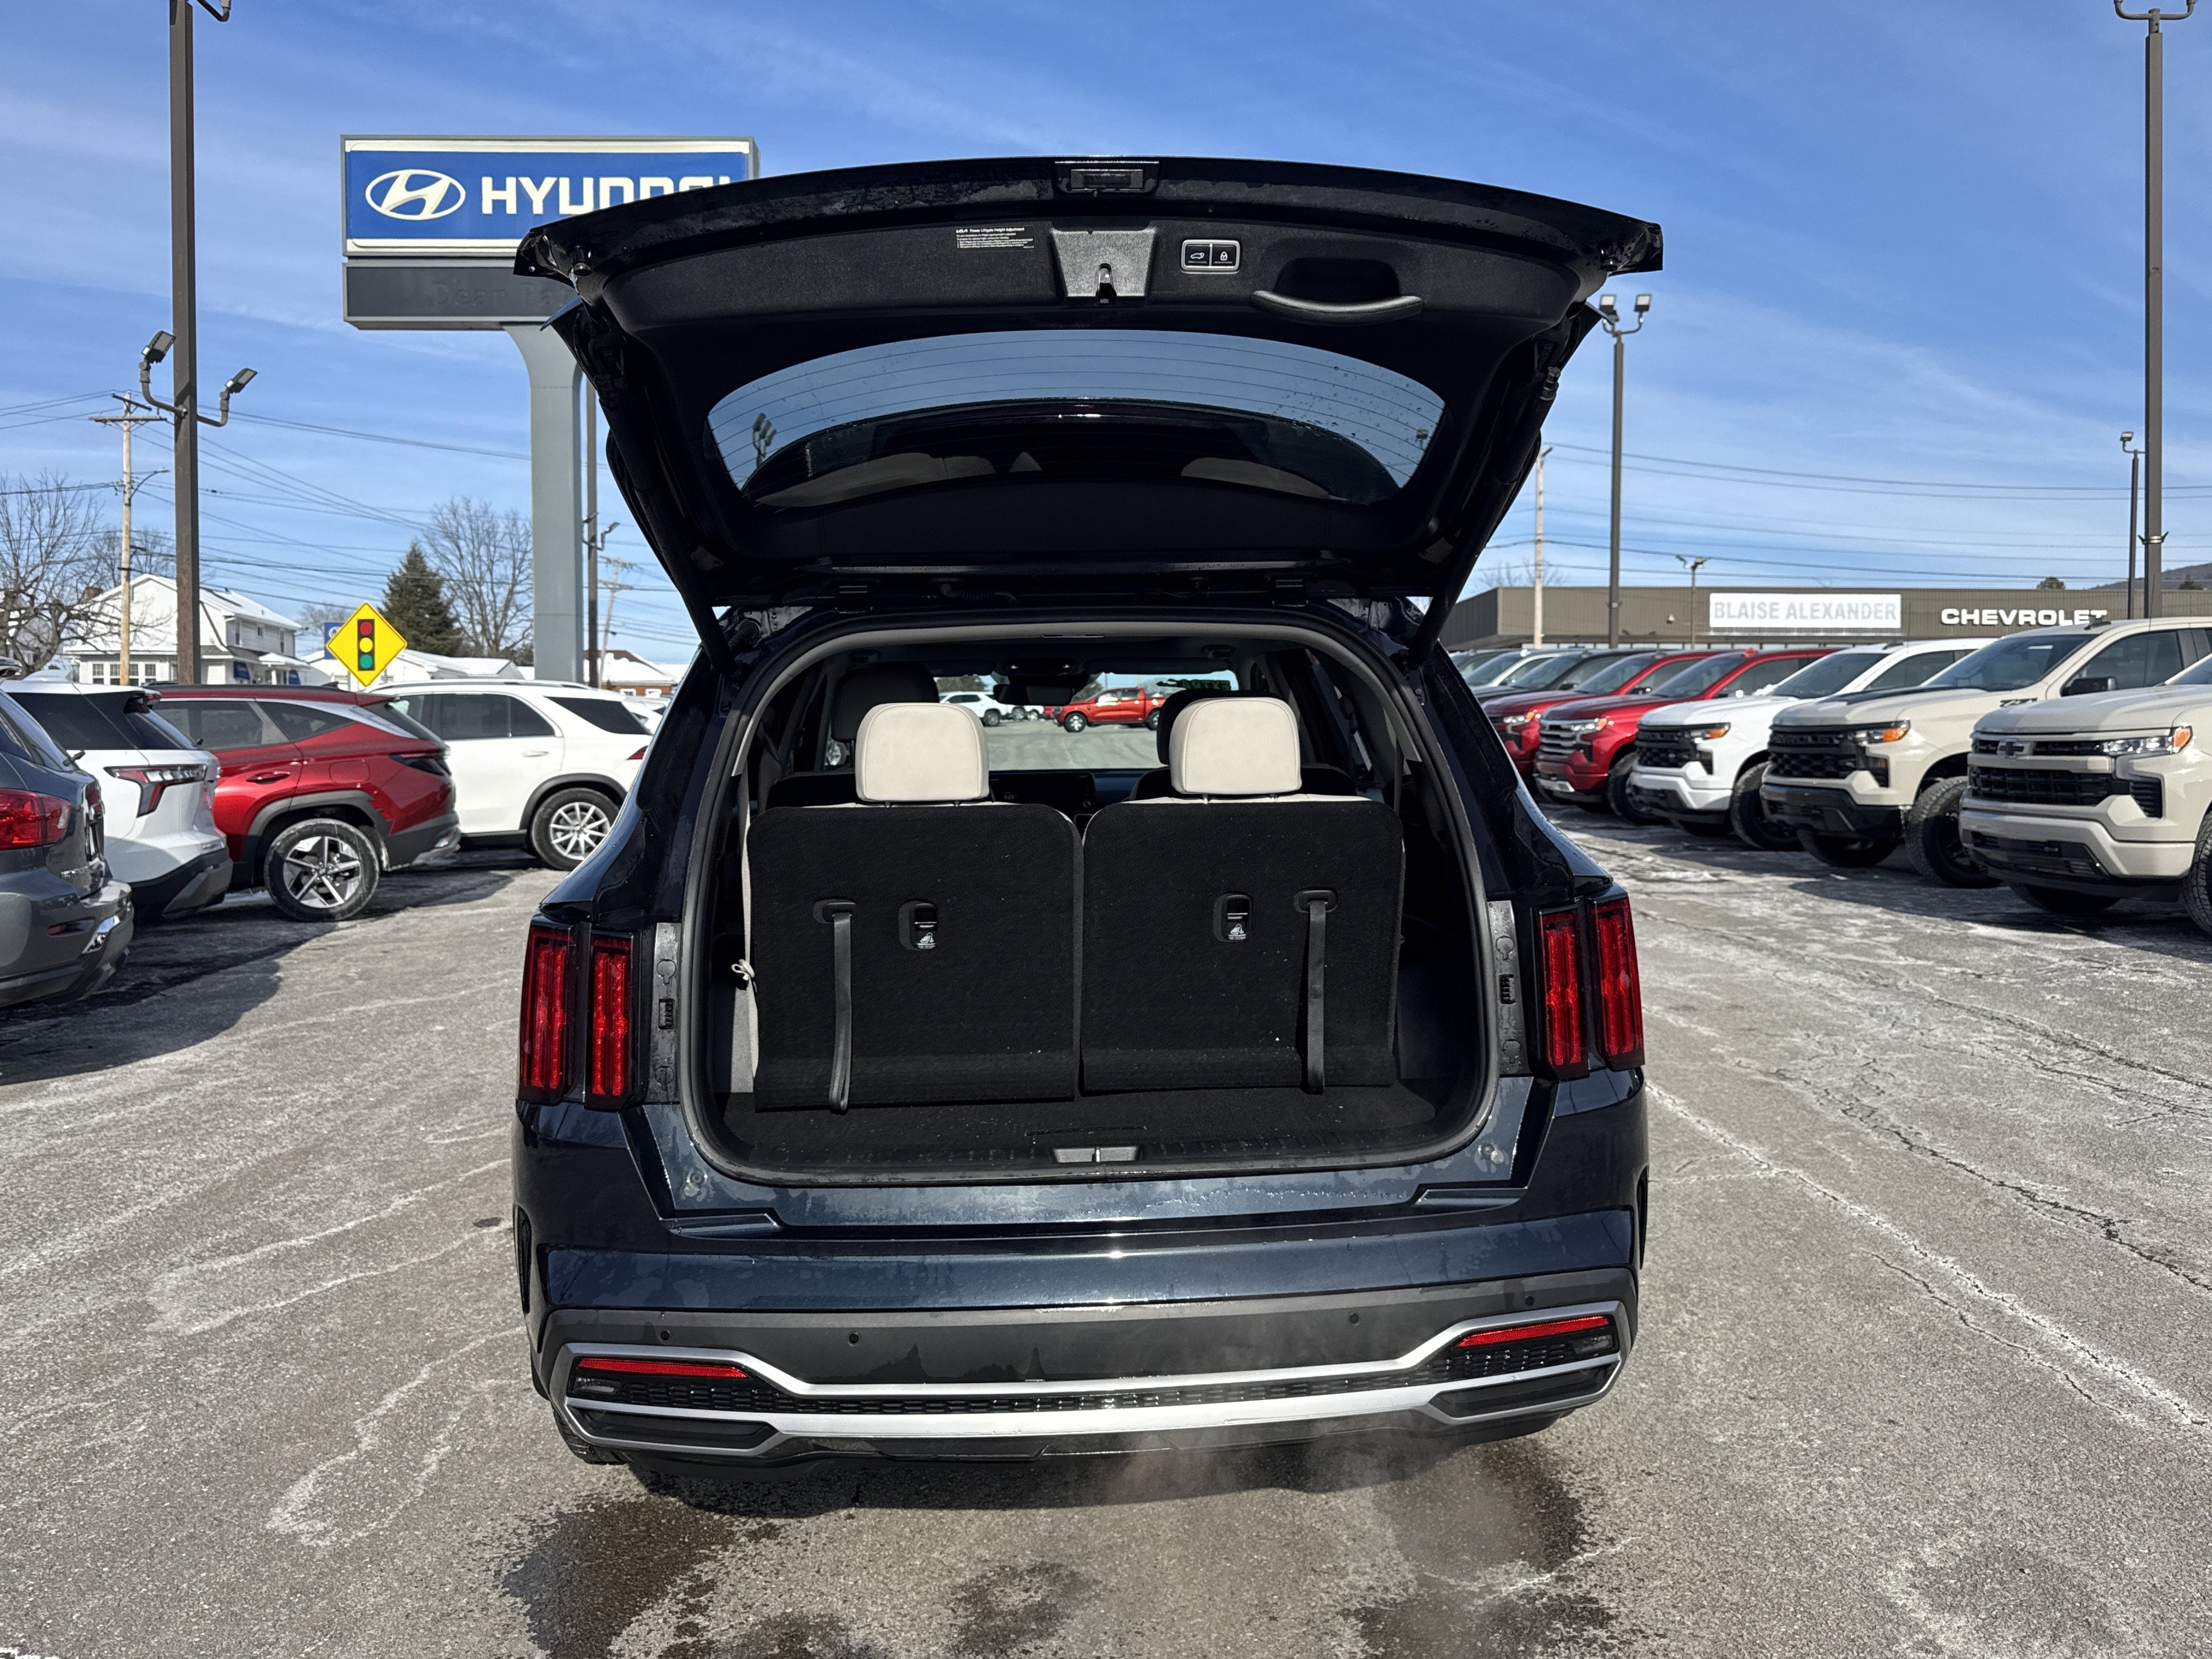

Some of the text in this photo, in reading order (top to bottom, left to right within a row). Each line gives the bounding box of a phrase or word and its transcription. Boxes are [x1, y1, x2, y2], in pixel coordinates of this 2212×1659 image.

[481, 176, 731, 215] HYUND
[1713, 601, 1897, 620] BLAISE ALEXANDER
[1940, 608, 2108, 627] CHEVROLET
